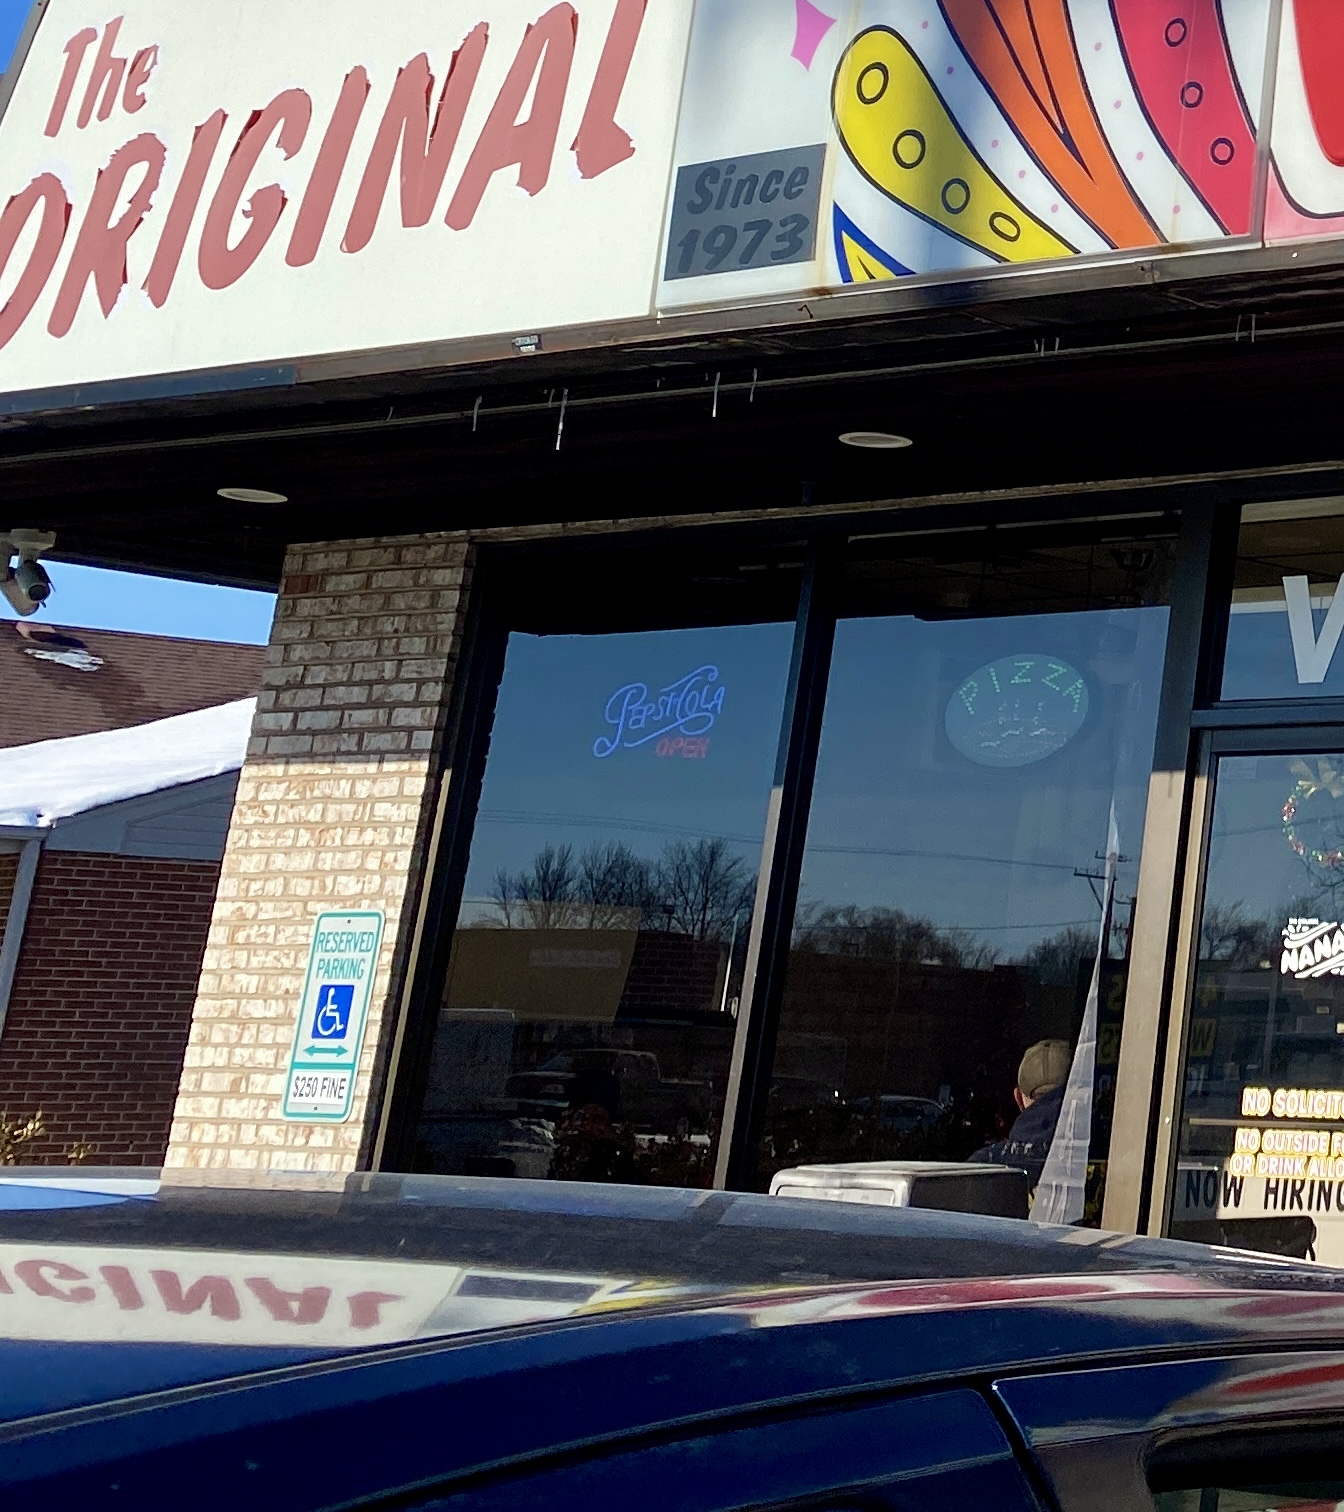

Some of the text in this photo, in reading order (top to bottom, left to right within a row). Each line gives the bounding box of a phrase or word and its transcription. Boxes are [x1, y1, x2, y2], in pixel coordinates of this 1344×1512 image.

[43, 15, 159, 137] The
[687, 163, 809, 215] Since
[677, 213, 808, 274] 1973
[958, 662, 1085, 714] PIZZA
[655, 737, 710, 758] OPEN
[316, 931, 375, 953] RESERVED
[315, 958, 366, 980] PARKING
[293, 1076, 346, 1100] $250 FINE
[1243, 1088, 1270, 1115] NO
[1236, 1129, 1259, 1152] NO
[1262, 1131, 1329, 1155] OUTSIDE
[1231, 1155, 1255, 1176] OR
[1256, 1156, 1306, 1179] DRINK
[1185, 1171, 1244, 1209] NOW
